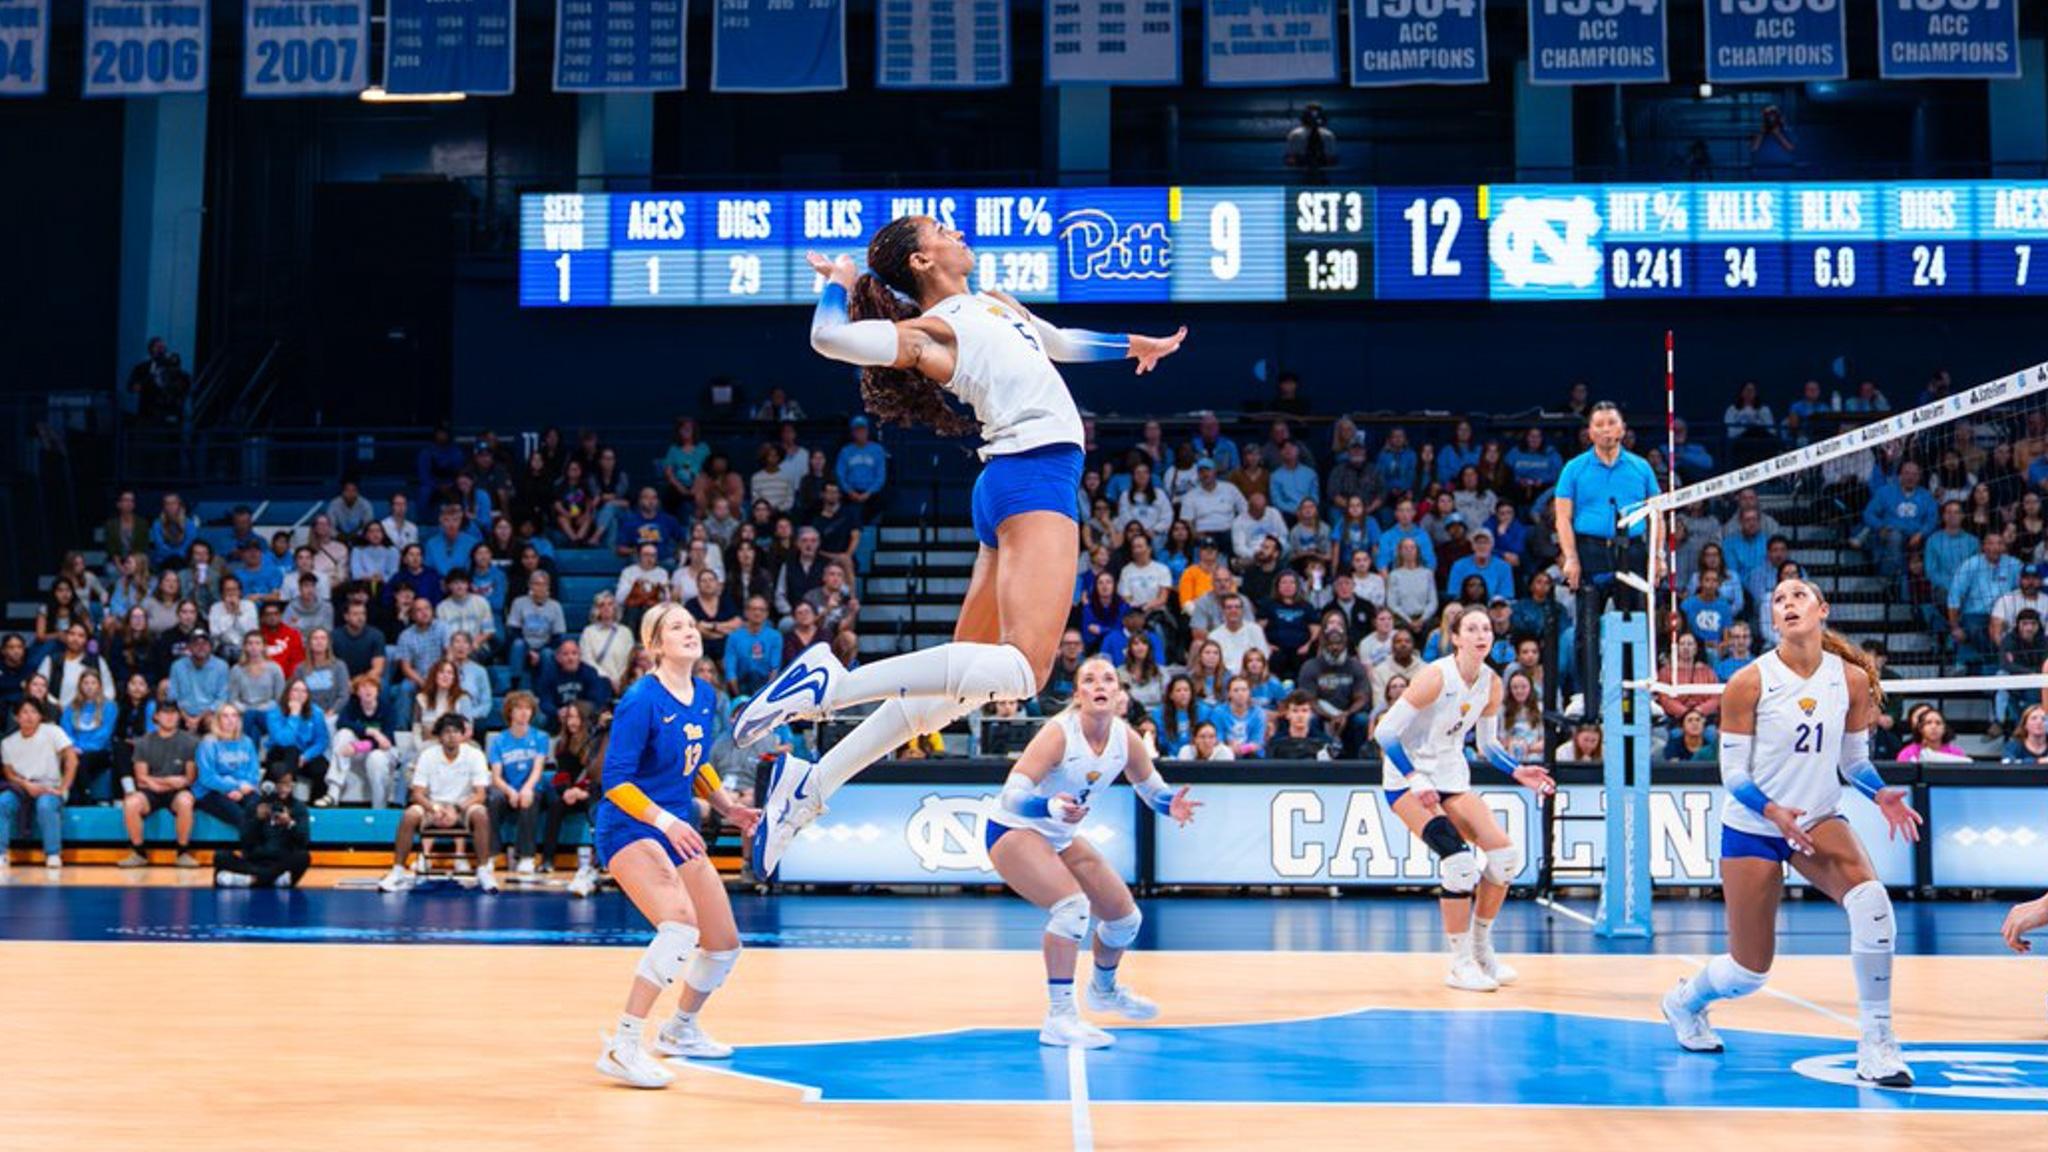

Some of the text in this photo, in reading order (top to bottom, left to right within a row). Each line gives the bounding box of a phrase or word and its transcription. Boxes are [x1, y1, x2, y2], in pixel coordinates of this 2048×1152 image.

[1400, 22, 1438, 43] ACC
[1578, 19, 1618, 41] ACC
[1755, 18, 1796, 39] ACC
[1928, 14, 1970, 36] ACC
[92, 37, 200, 83] 2006
[256, 37, 358, 84] 2007
[1363, 47, 1476, 71] CHAMPIONS
[1541, 45, 1655, 69] CHAMPIONS
[1717, 43, 1834, 67] CHAMPIONS
[1891, 41, 2009, 63] CHAMPIONS
[543, 194, 583, 222] SETS
[627, 200, 687, 241] ACES
[717, 199, 772, 241] DIGS
[803, 198, 863, 239] BLKS
[975, 195, 1053, 238] HIT %
[1297, 191, 1362, 233] SET 3
[1609, 190, 1688, 232] HIT %
[1706, 190, 1774, 231] KILLS
[1800, 190, 1861, 230] BLKS
[1898, 189, 1956, 230] DIGS
[1993, 188, 2048, 229] ACES
[543, 223, 583, 251] WON
[1058, 208, 1172, 281] Pitt
[1210, 200, 1242, 281] 9
[1403, 197, 1462, 277] 12
[555, 253, 571, 303] 1
[645, 256, 660, 294] 1
[728, 254, 762, 295] 29
[978, 252, 1048, 292] 0.329
[1304, 249, 1358, 291] 1:30
[1611, 247, 1683, 289] 0.241
[1724, 246, 1757, 288] 34
[1814, 246, 1855, 288] 6.0
[1912, 245, 1947, 287] 24
[2014, 244, 2032, 286] 7
[1794, 722, 1824, 754] 21
